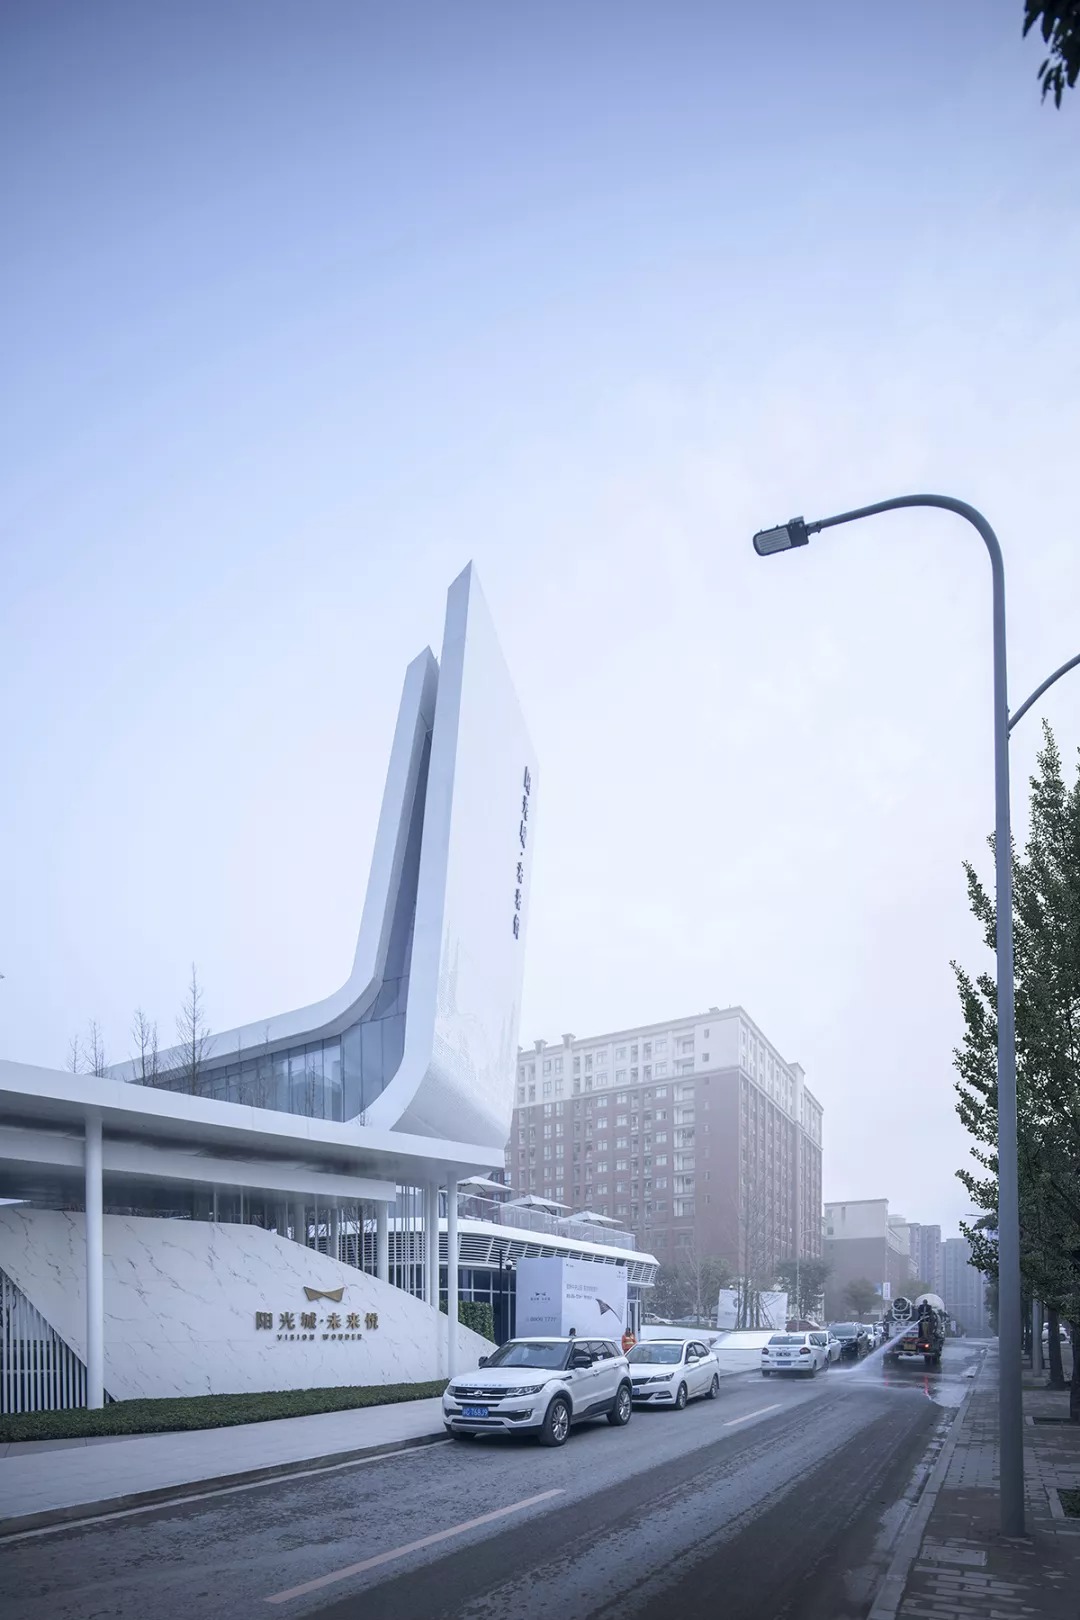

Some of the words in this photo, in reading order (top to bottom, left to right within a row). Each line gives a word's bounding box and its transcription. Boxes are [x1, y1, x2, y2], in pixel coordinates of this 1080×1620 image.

[255, 1311, 379, 1330] 阳光城·未来悦
